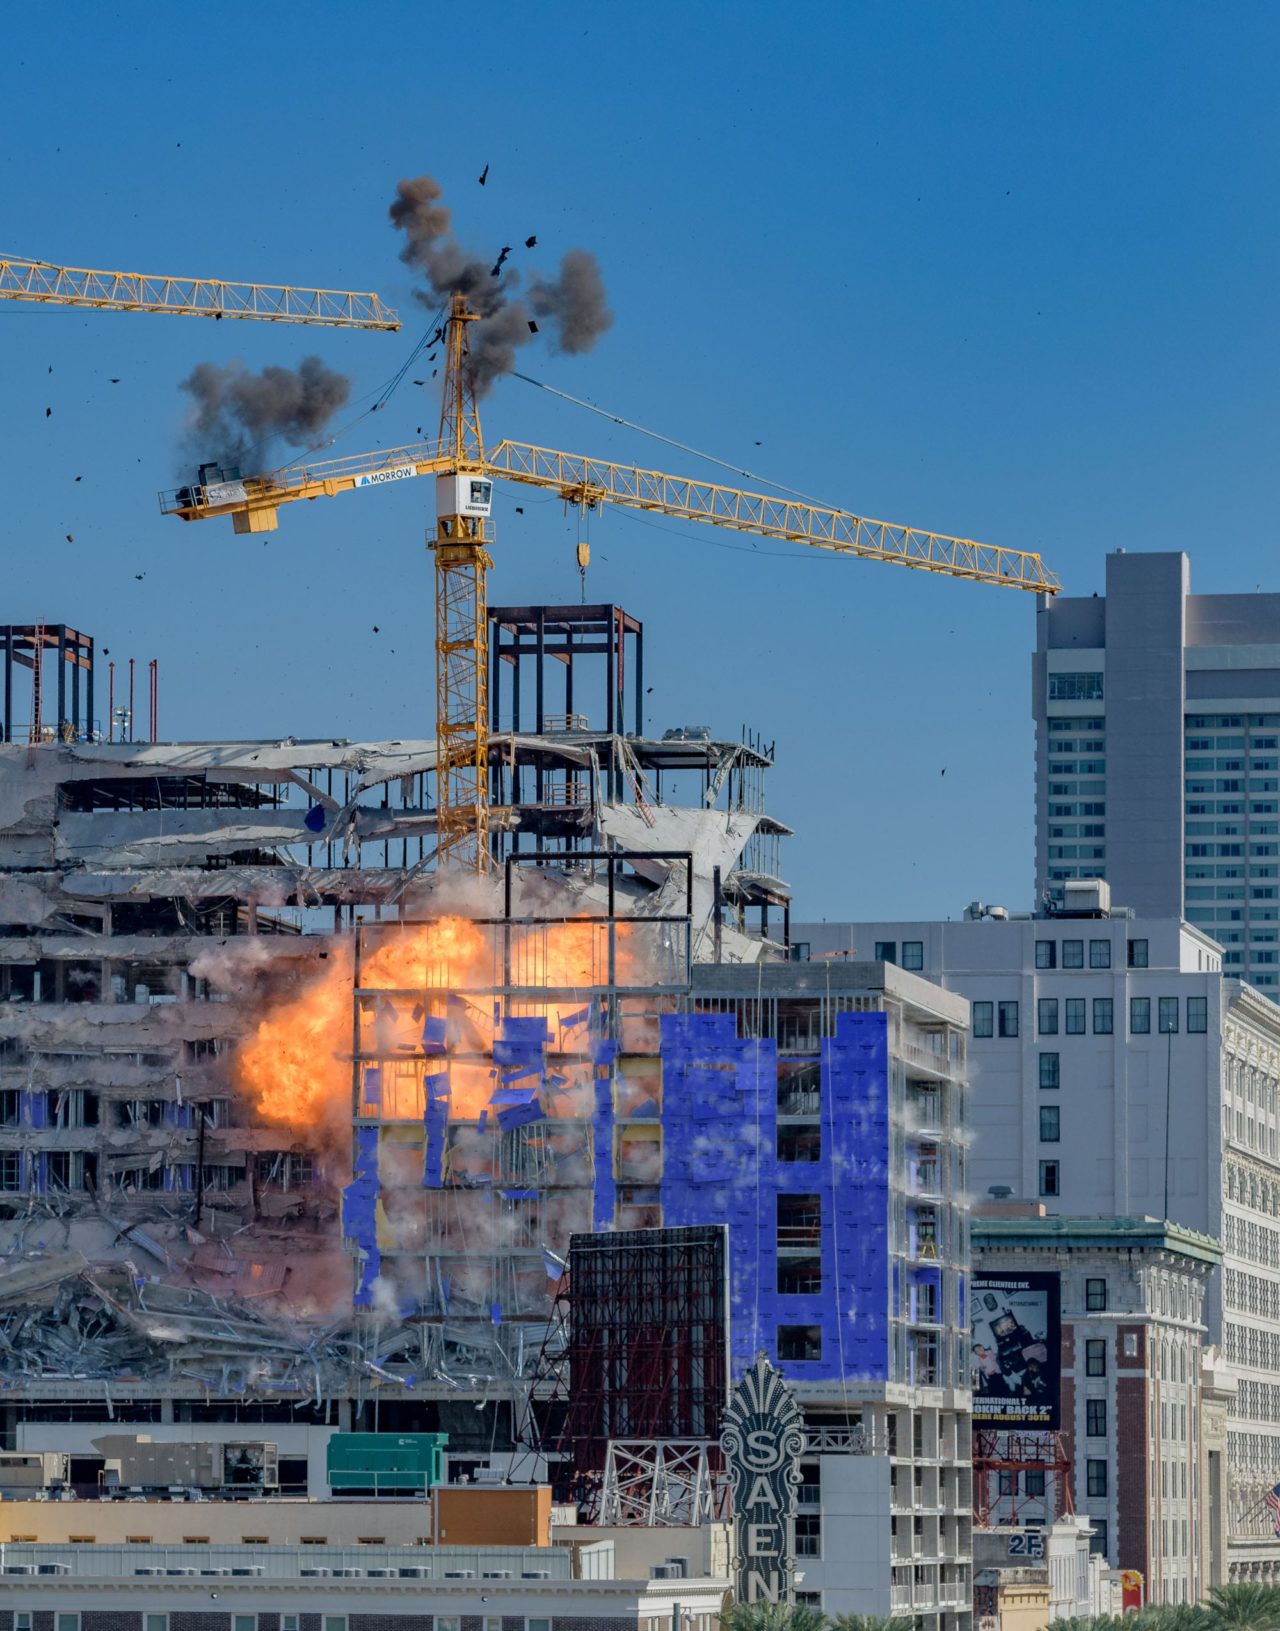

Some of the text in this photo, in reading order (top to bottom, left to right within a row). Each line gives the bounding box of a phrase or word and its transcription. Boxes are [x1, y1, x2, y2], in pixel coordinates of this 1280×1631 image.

[371, 467, 412, 483] MORROW
[1020, 1397, 1027, 1405] T
[1006, 1405, 1037, 1414] BACK
